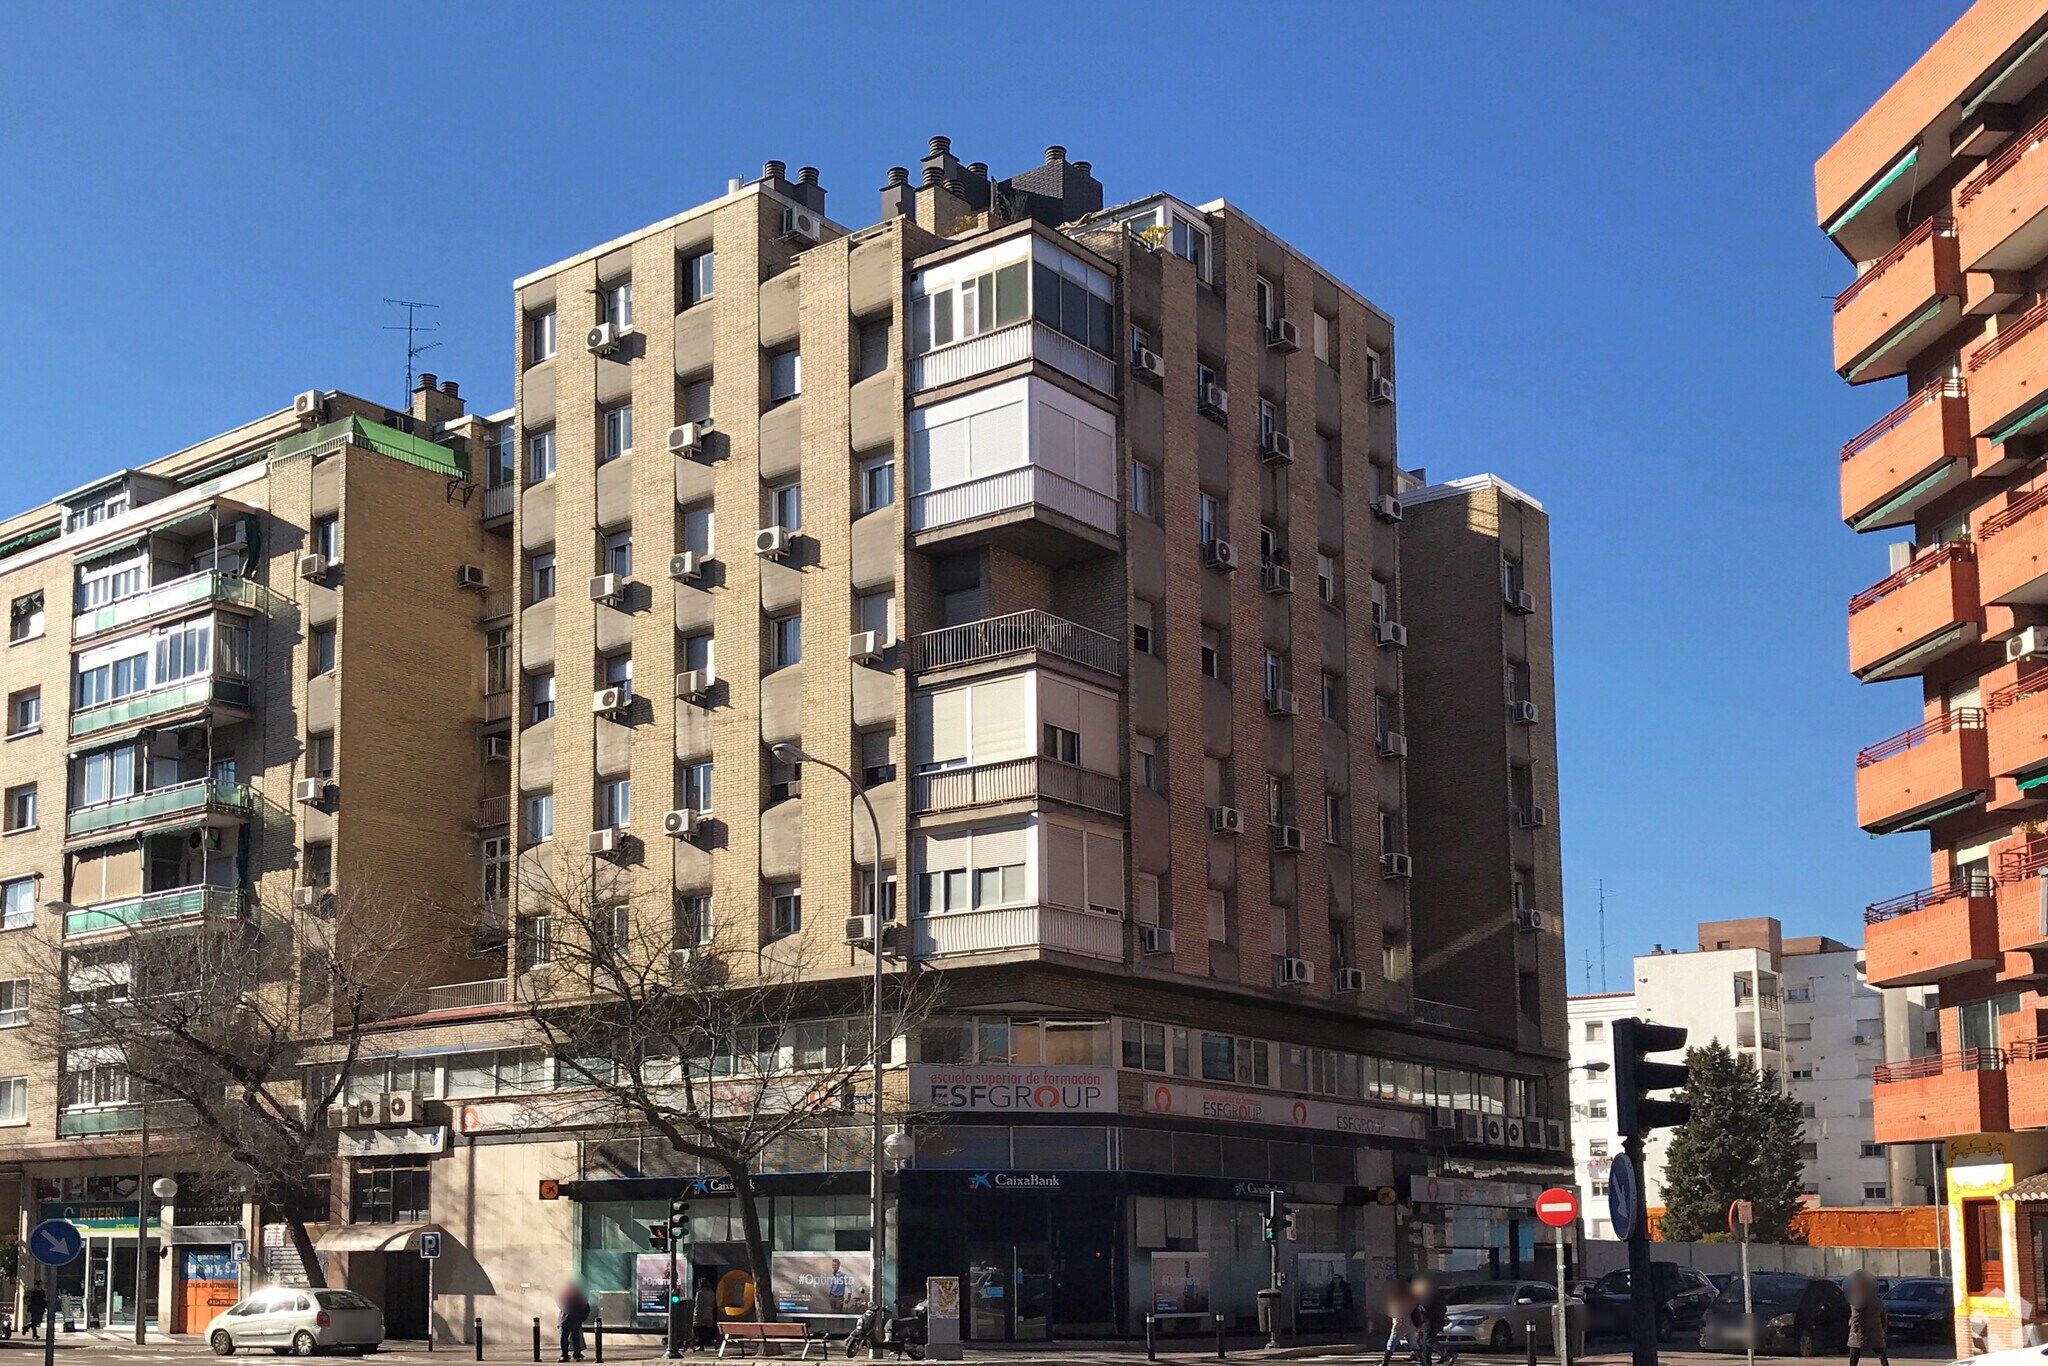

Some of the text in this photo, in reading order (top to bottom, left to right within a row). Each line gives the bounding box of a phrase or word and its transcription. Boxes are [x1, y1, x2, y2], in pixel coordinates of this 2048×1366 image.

[931, 1069, 1100, 1087] escuela superior de formación
[931, 1085, 1101, 1108] ESFGROUP
[1203, 1101, 1262, 1120] ESFGROUP
[710, 1179, 756, 1190] Caixak
[995, 1173, 1060, 1186] CaixaBank
[80, 1206, 124, 1220] INTERNI
[799, 1273, 855, 1288] #Optimista
